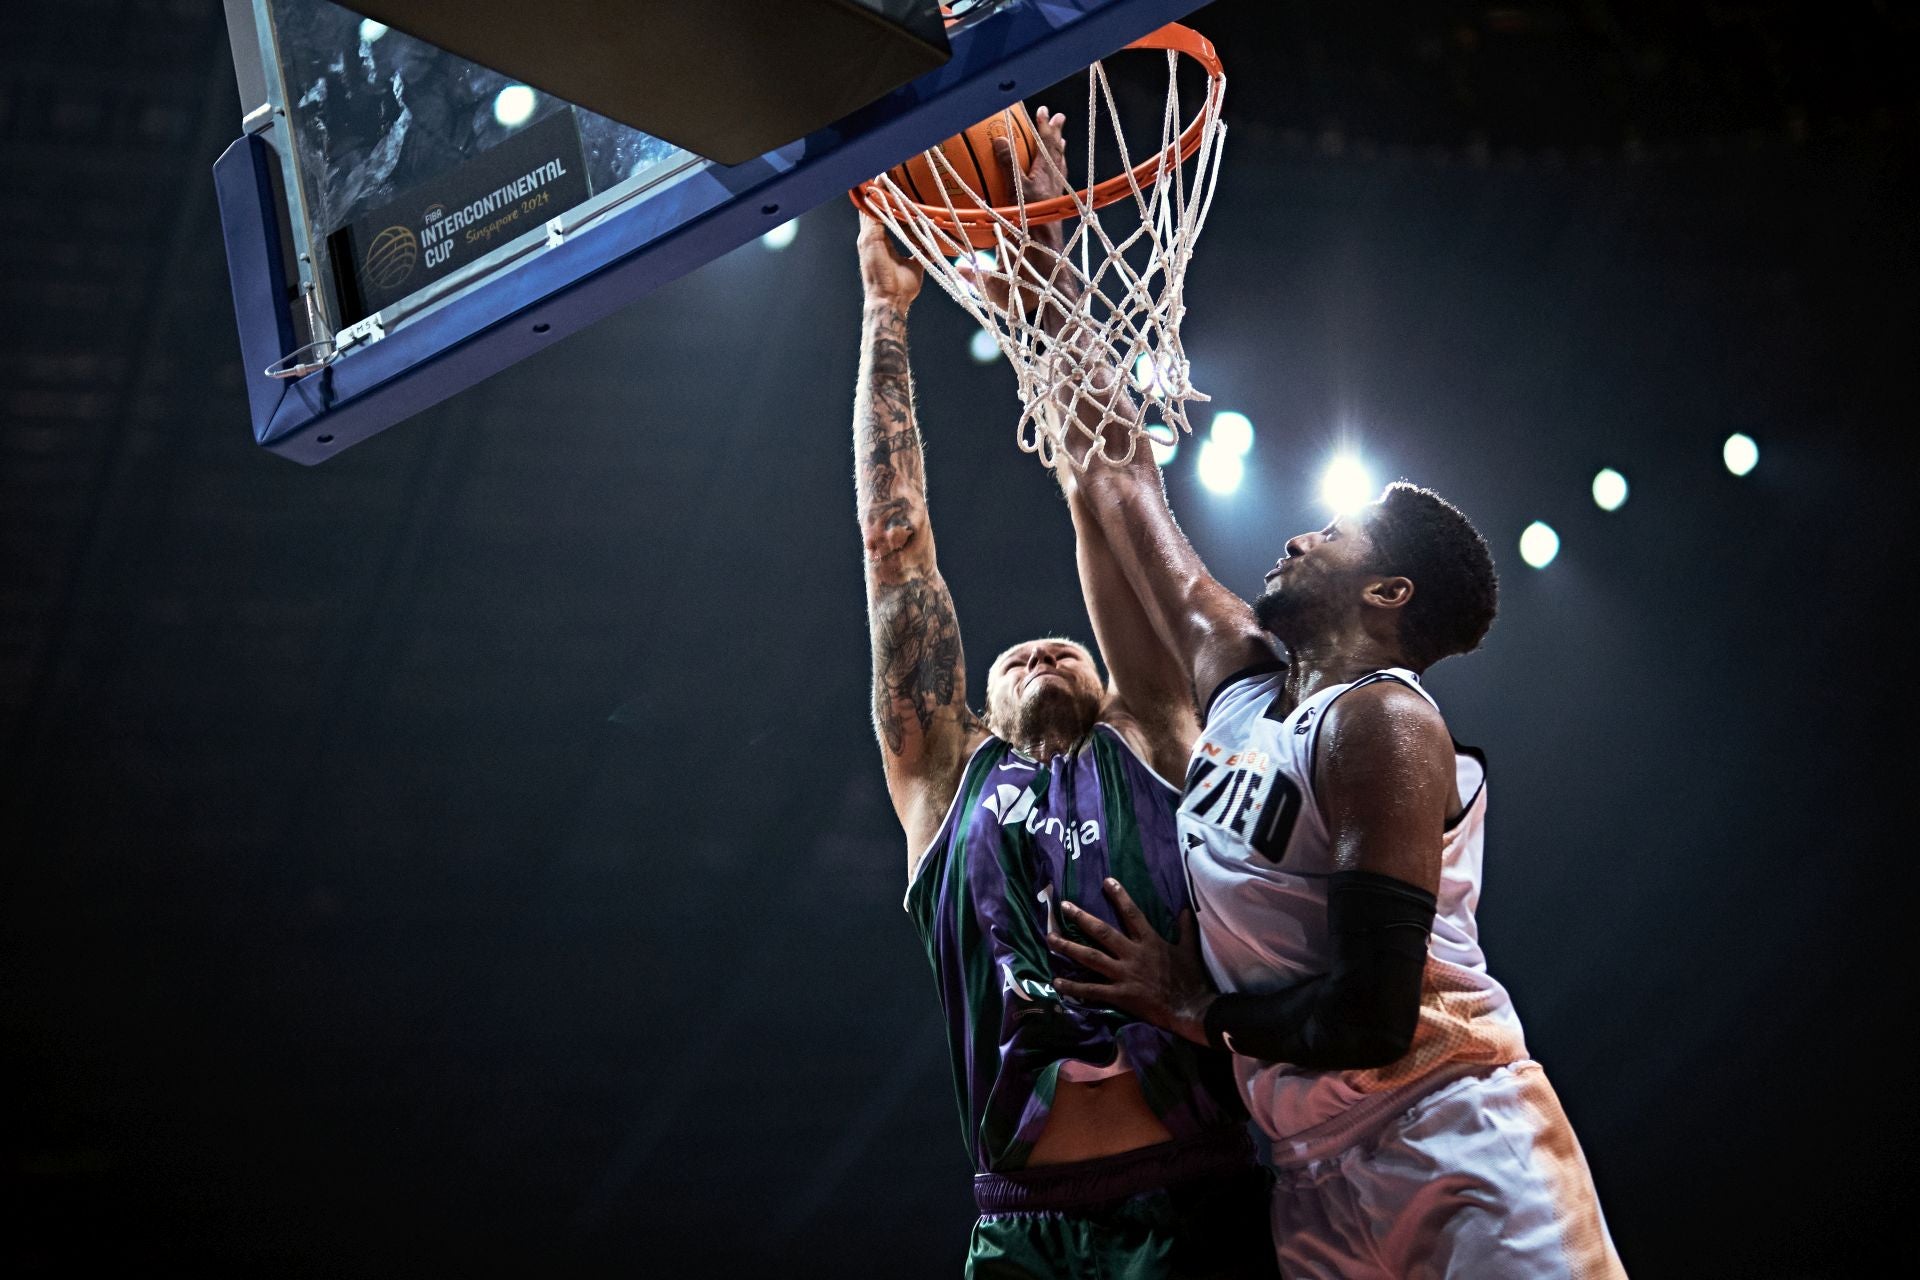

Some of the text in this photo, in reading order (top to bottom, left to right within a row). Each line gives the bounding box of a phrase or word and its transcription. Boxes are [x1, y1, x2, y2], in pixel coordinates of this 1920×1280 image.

[421, 158, 567, 248] INTERCONTINENTAL
[425, 209, 442, 225] FIBA
[466, 191, 550, 244] Singapore 2024
[425, 239, 454, 268] CUP
